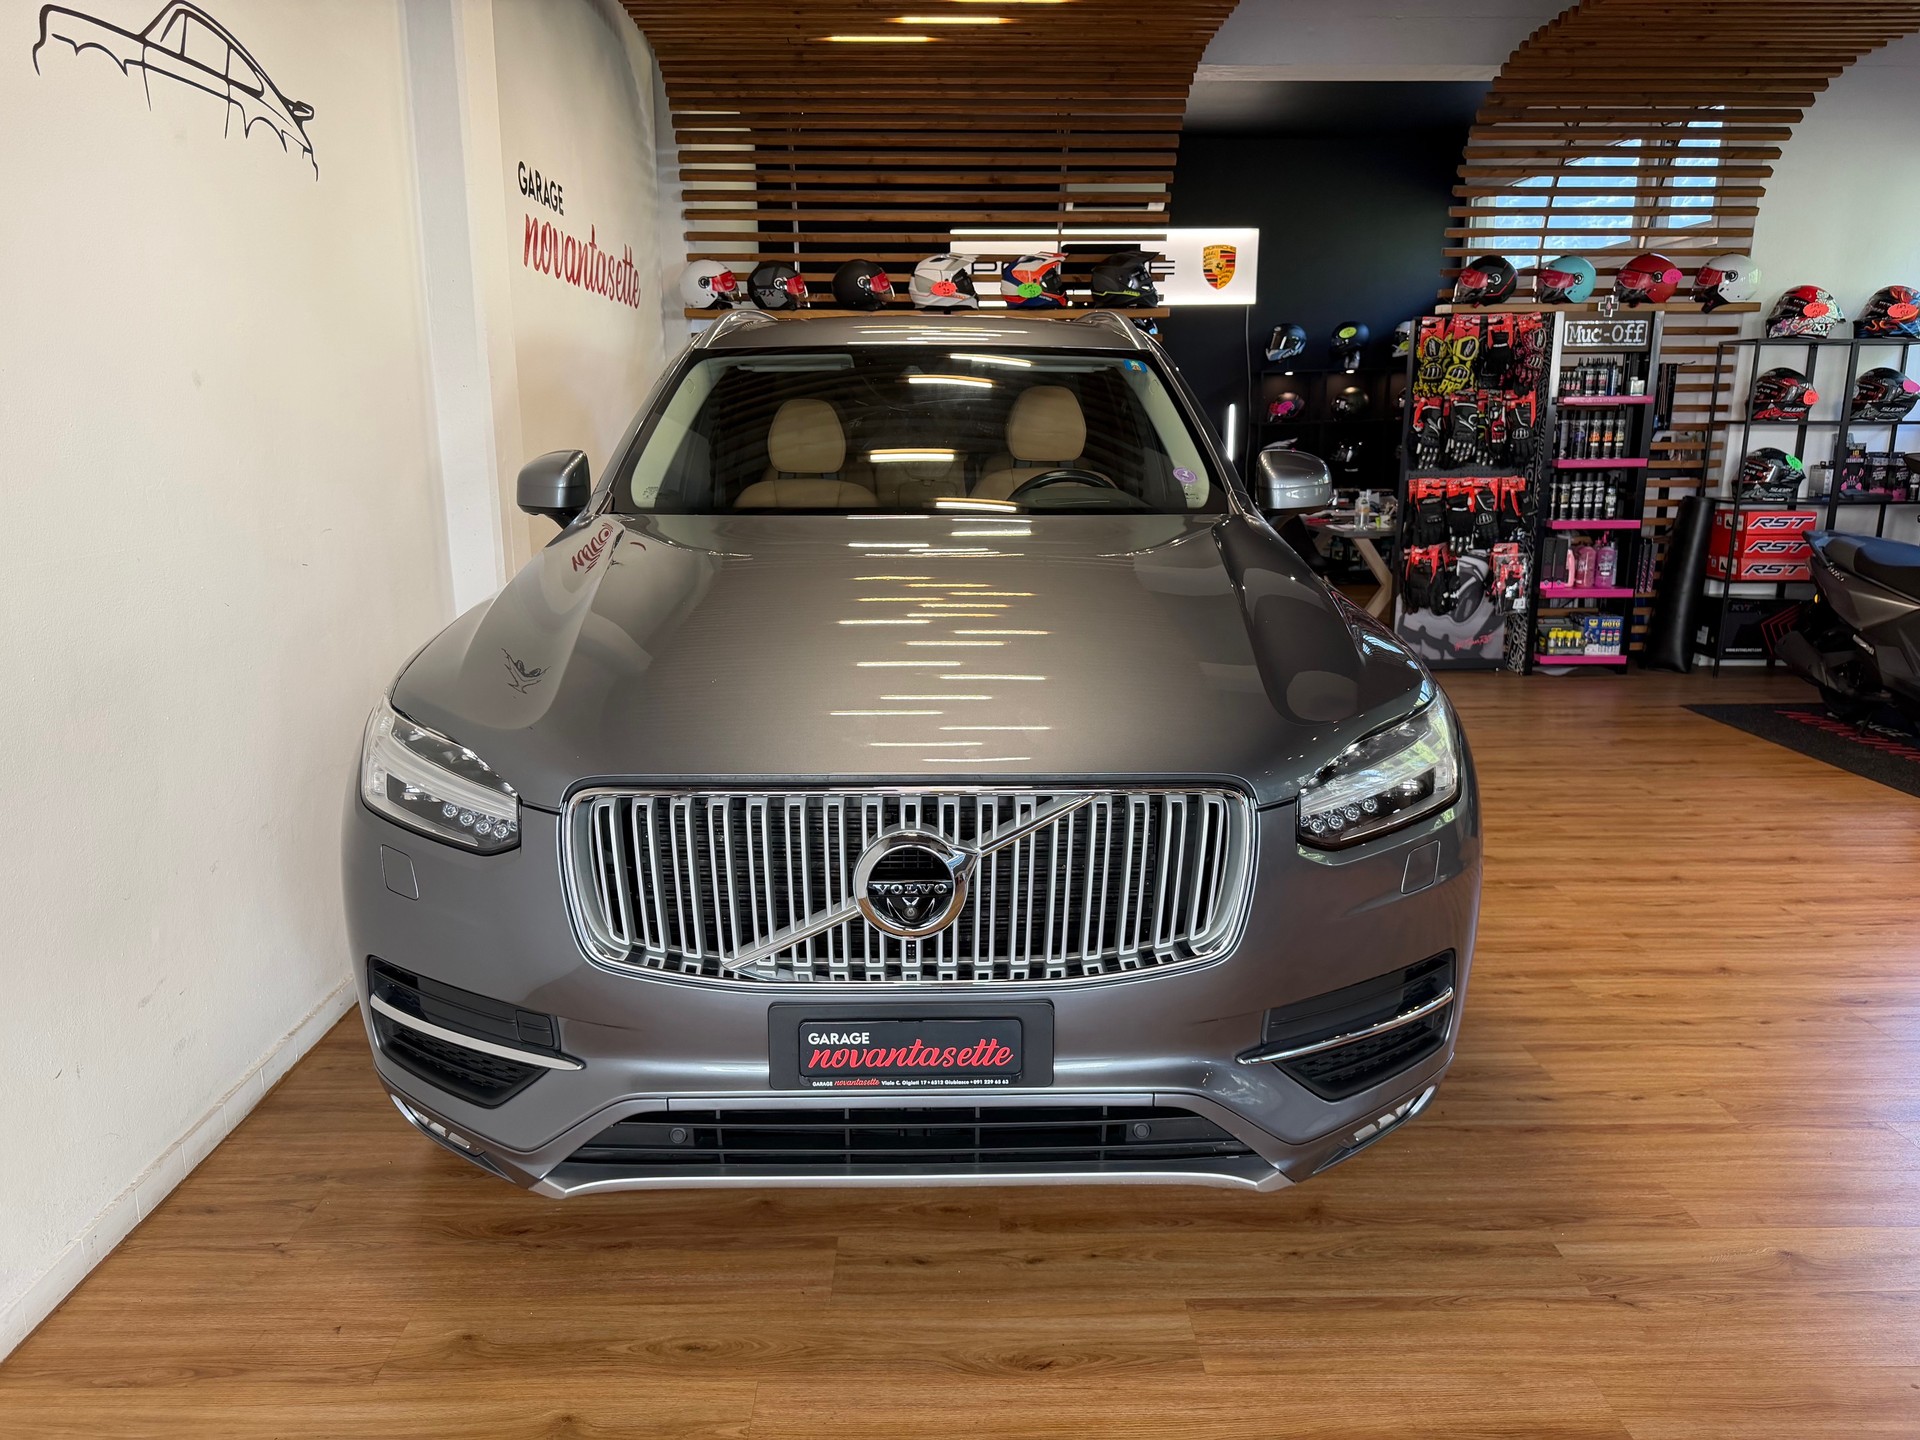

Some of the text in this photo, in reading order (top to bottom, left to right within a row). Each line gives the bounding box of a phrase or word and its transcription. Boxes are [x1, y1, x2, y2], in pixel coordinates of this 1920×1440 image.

[517, 160, 565, 216] GARAGE
[524, 213, 641, 309] novantasette
[1568, 323, 1645, 343] Muc-Off
[1747, 516, 1815, 530] RST
[1744, 539, 1812, 554] RST
[1741, 563, 1807, 576] RST
[872, 883, 948, 895] VOLVO
[807, 1032, 870, 1045] GARAGE
[808, 1037, 1014, 1068] novantasette
[834, 1078, 880, 1086] novantasette
